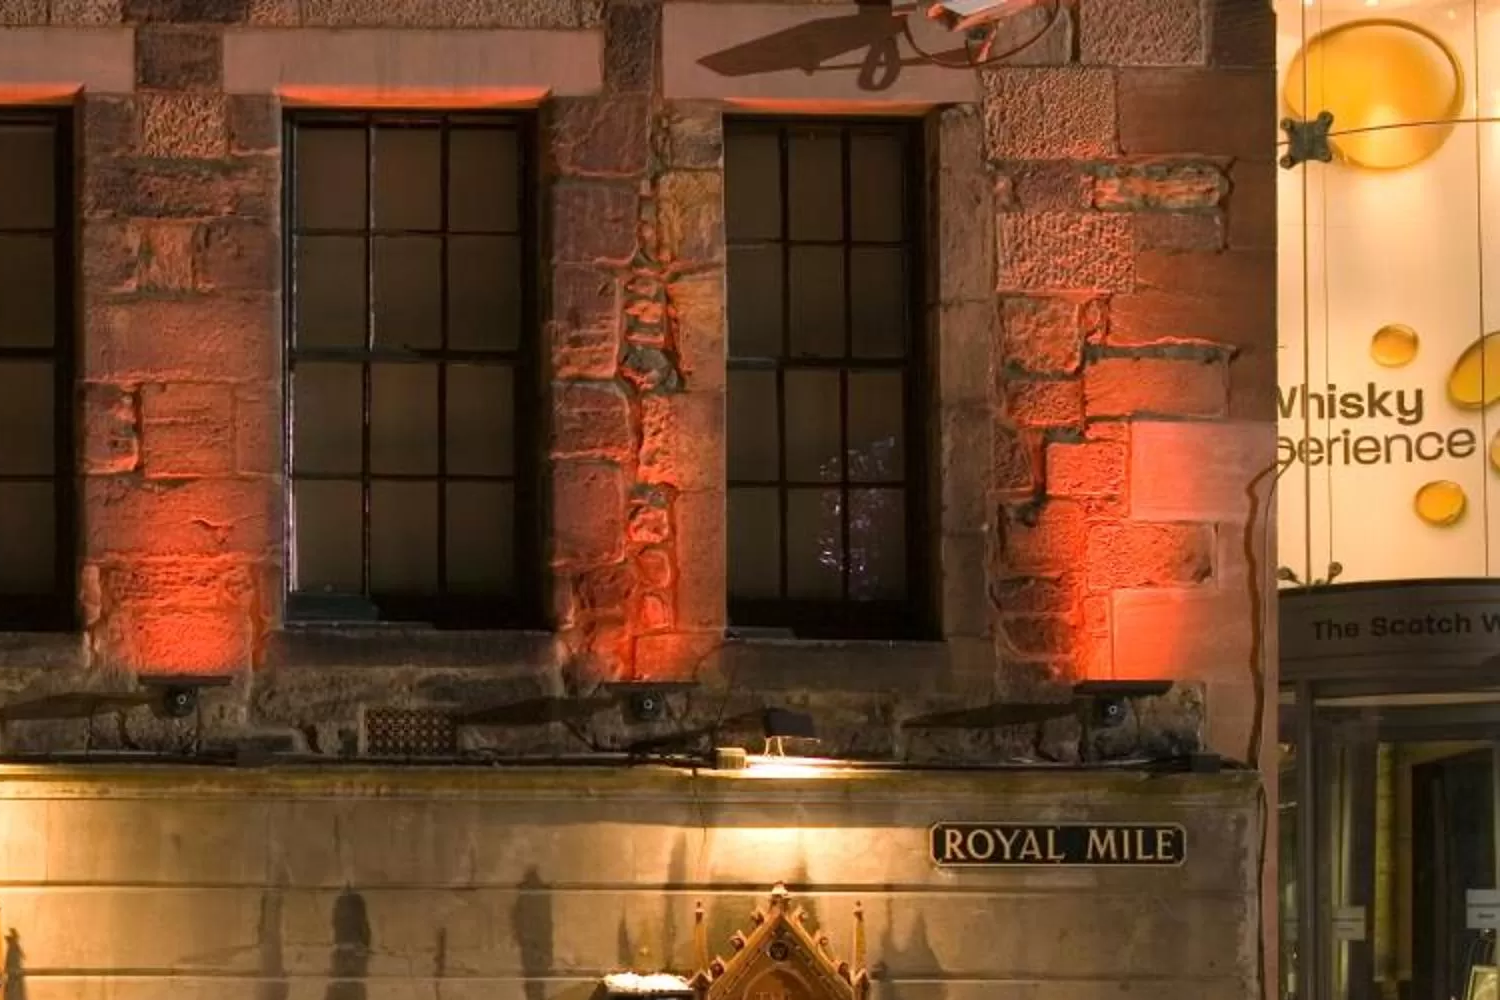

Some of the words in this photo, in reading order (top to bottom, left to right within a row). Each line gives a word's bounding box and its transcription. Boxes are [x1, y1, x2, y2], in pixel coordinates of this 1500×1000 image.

[1312, 618, 1360, 641] The
[1369, 612, 1472, 638] Scotch
[944, 828, 1065, 861] ROYAL
[1087, 828, 1175, 861] MILE
